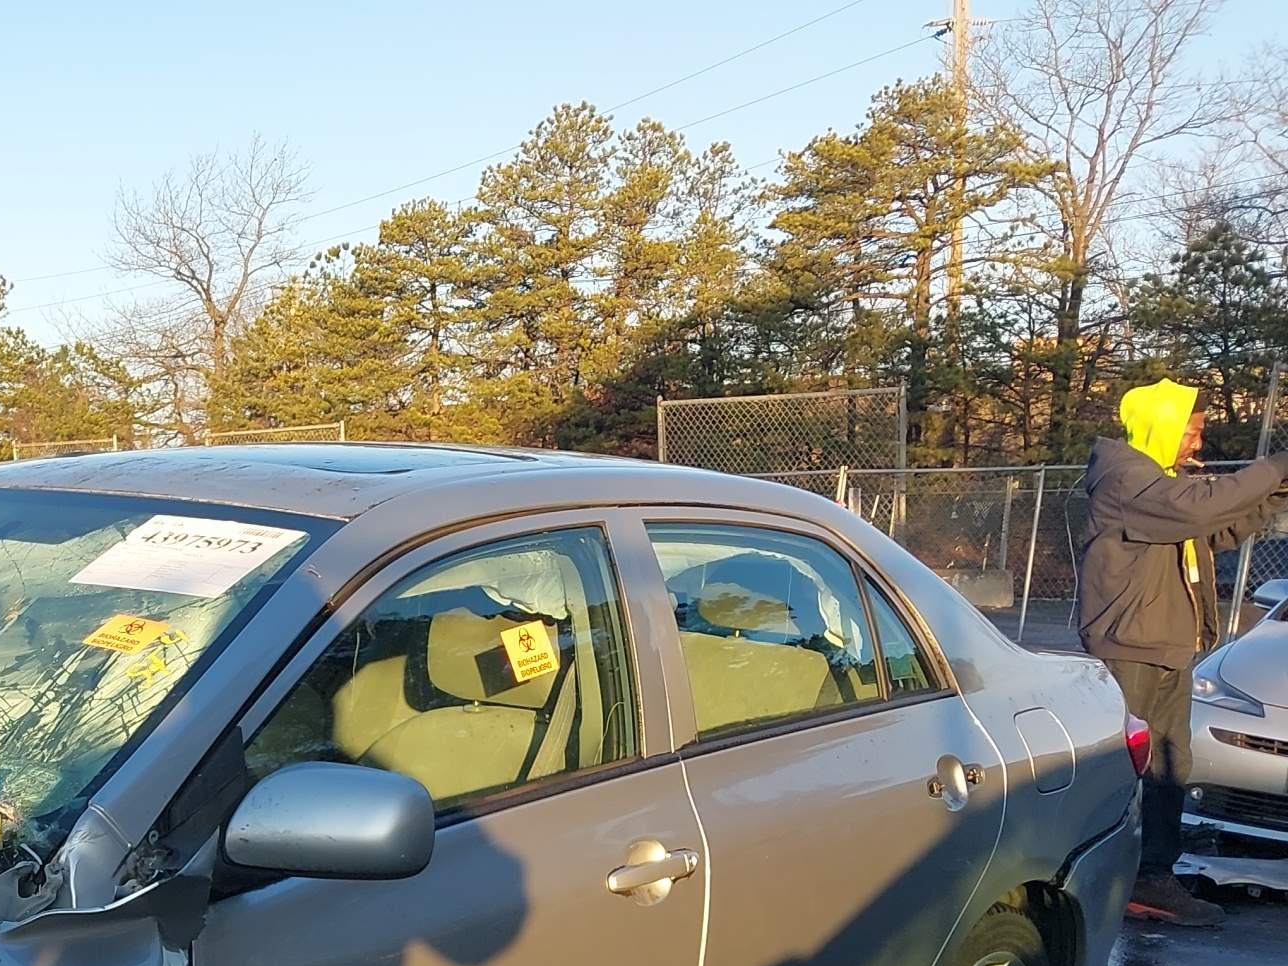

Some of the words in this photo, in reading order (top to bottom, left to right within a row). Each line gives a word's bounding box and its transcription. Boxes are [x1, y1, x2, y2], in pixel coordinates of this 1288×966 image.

[141, 530, 263, 554] 43975973
[98, 633, 141, 645] BIOHAZARD
[517, 652, 549, 668] BIOHAZARD
[520, 662, 552, 678] BIOPELIGRO
